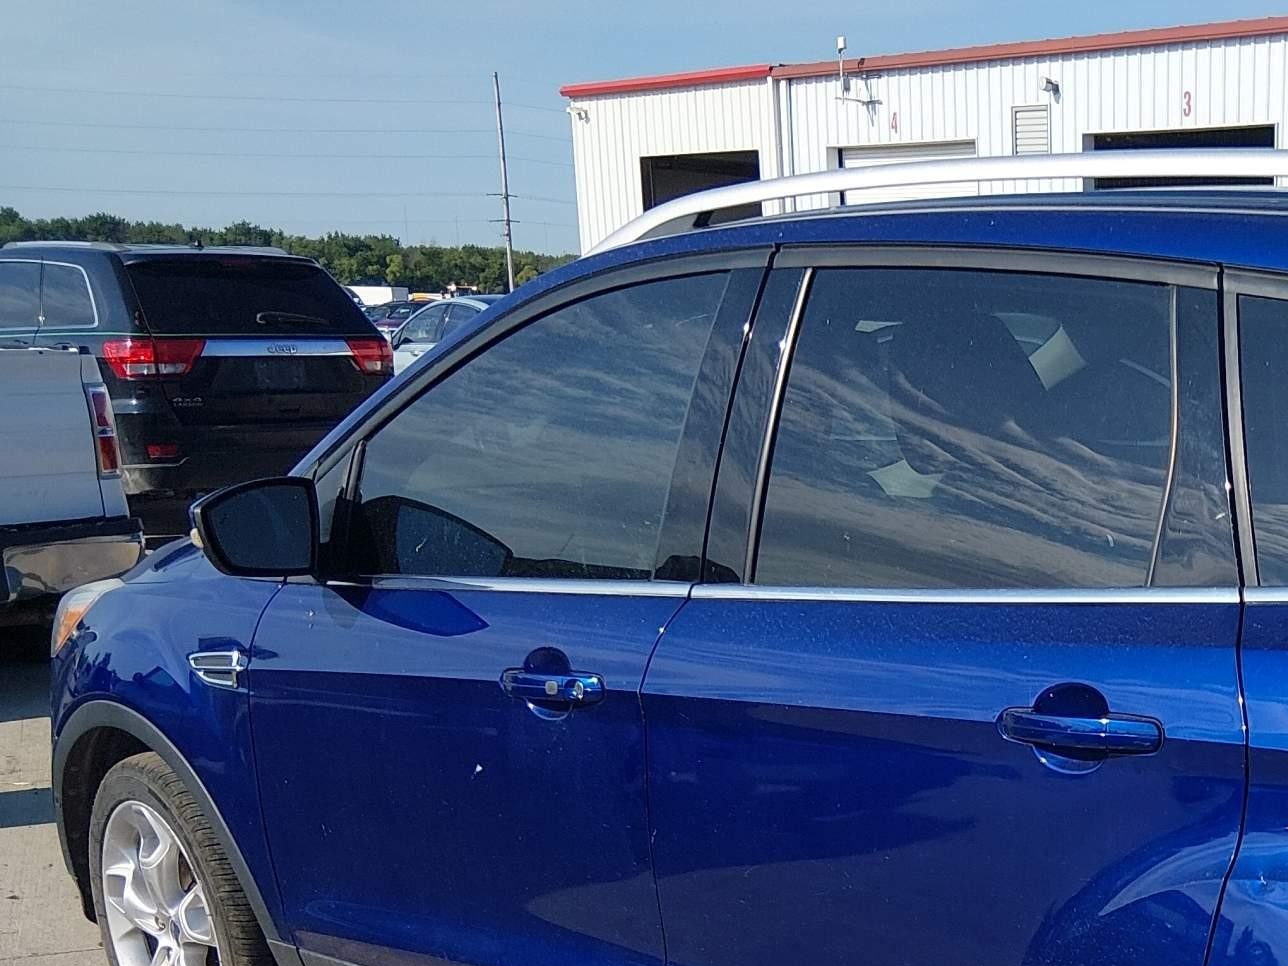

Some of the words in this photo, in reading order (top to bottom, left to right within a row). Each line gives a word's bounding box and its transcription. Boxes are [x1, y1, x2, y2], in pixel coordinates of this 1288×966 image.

[1184, 91, 1192, 117] 3
[891, 112, 898, 134] 4
[266, 343, 298, 354] Jeep
